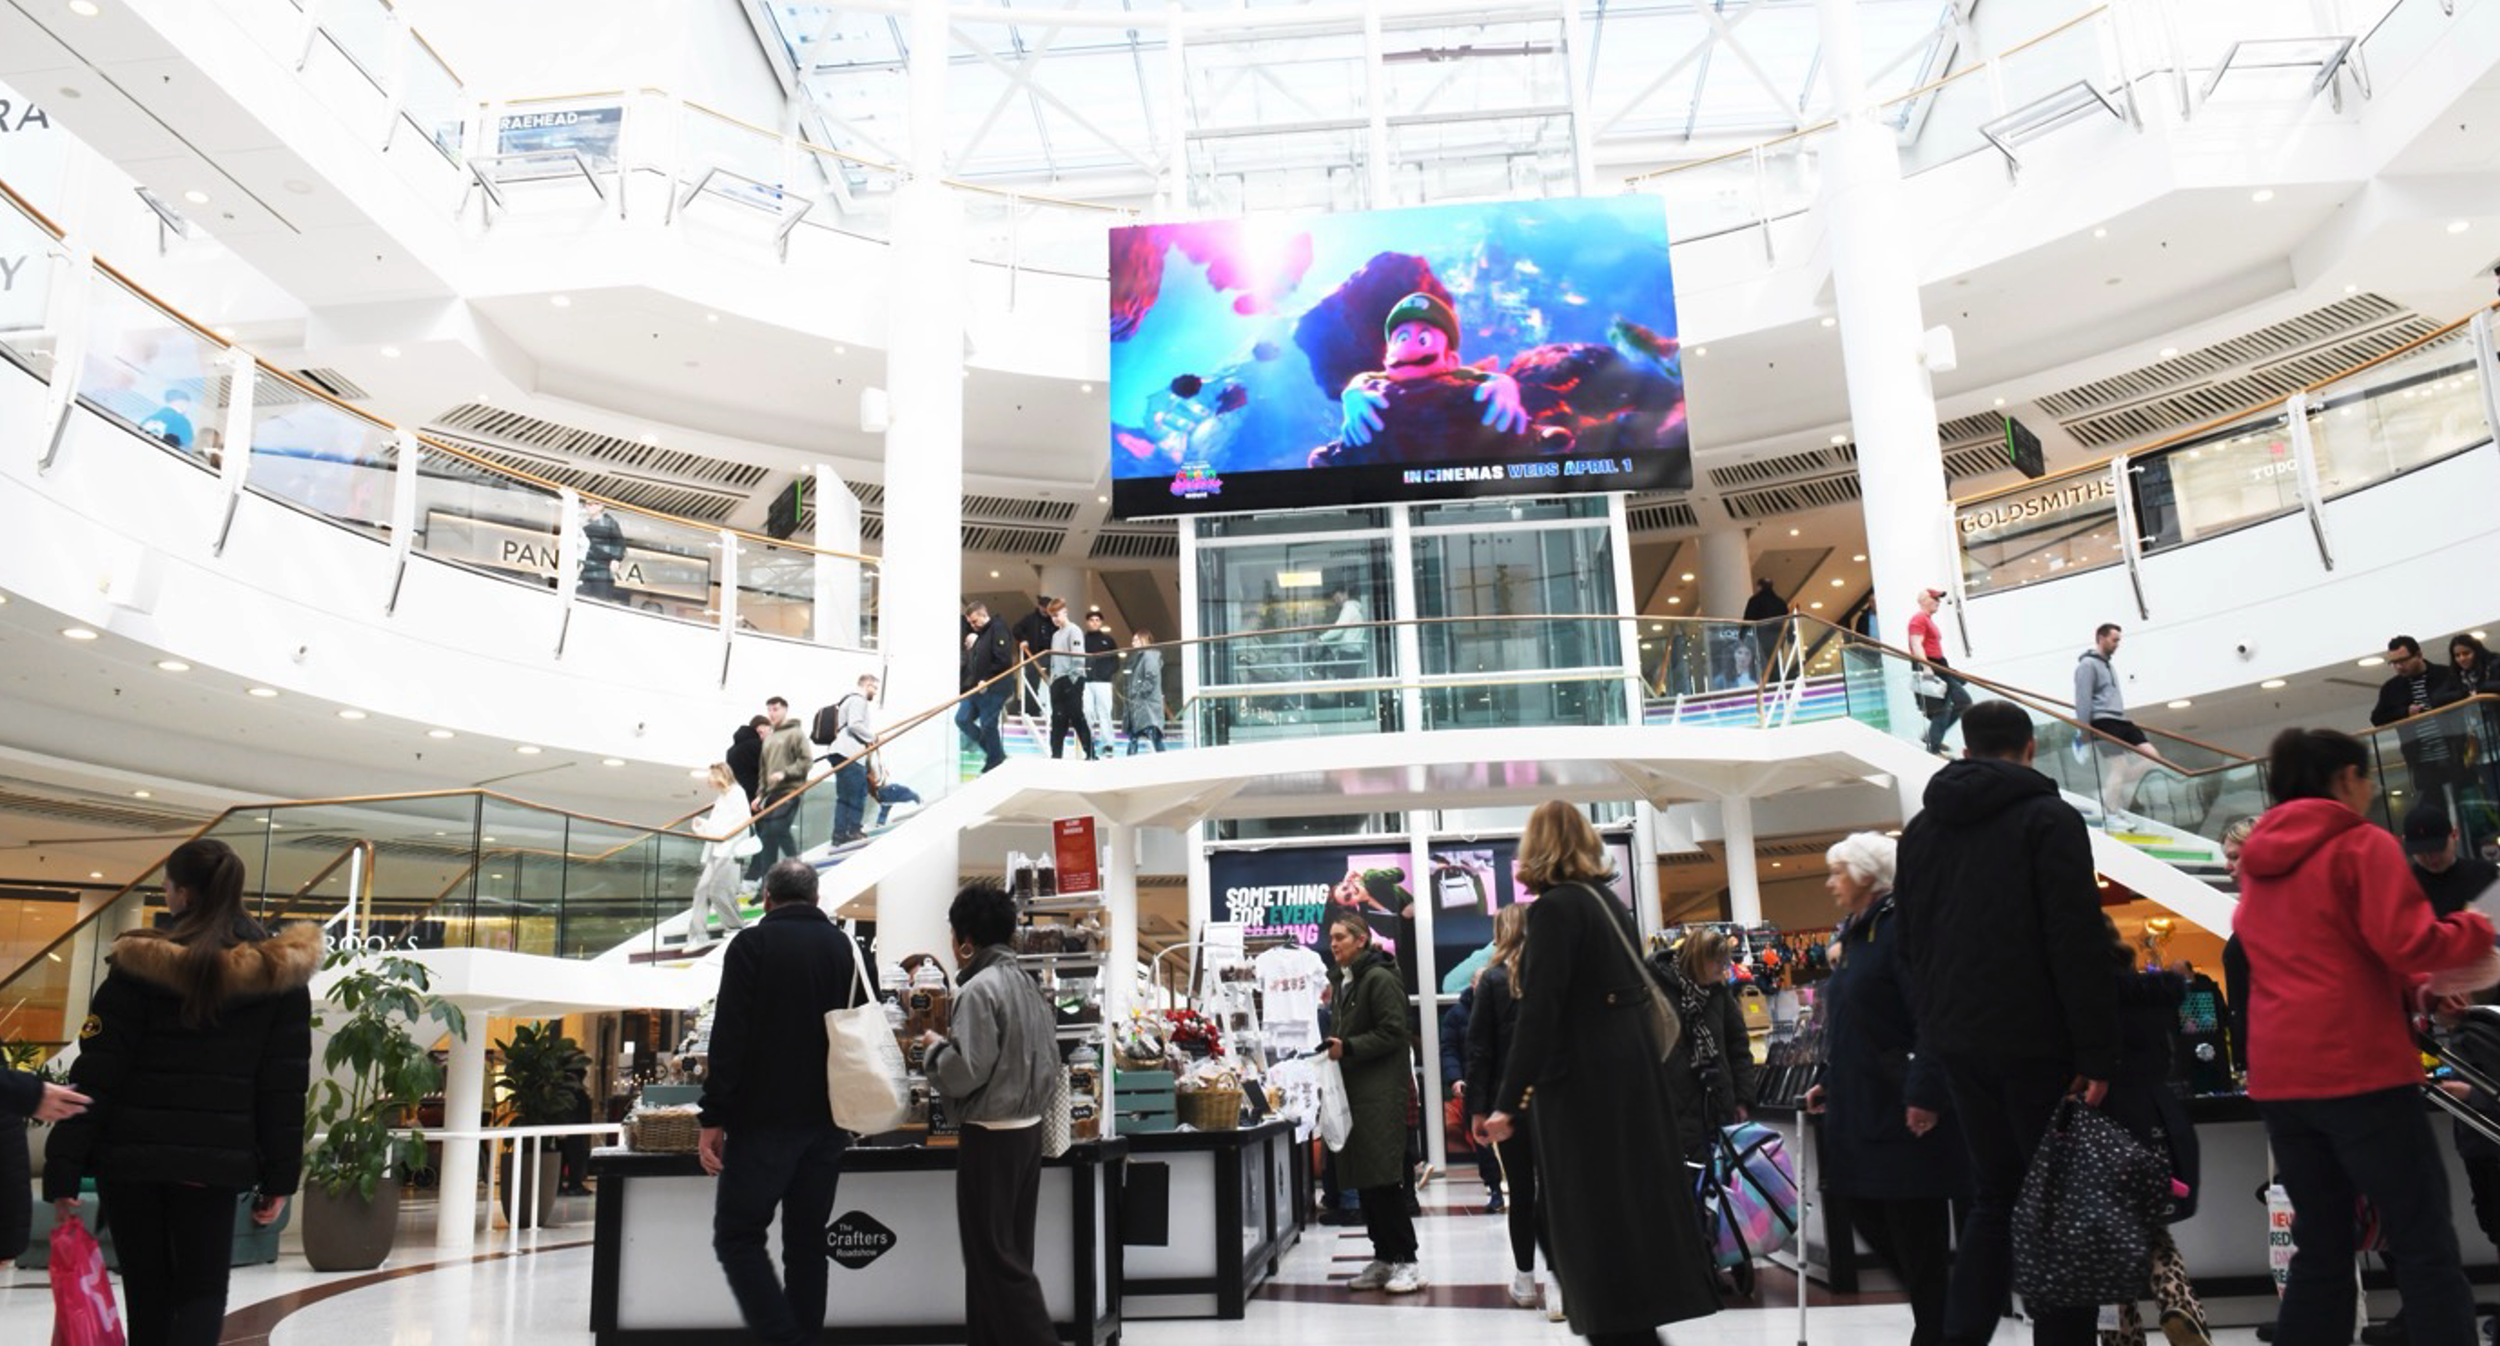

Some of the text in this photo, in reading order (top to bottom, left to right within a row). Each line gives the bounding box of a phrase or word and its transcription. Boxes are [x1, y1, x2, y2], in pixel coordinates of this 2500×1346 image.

[1403, 458, 1634, 484] IN CINEMAS WEDS APRIL 1
[2250, 458, 2298, 480] TUDO
[1960, 476, 2117, 534] GOLDSMITHS
[502, 539, 646, 585] PANA
[1225, 884, 1331, 909] SOMETHING
[1229, 904, 1326, 927] FOR EVERY
[839, 1222, 853, 1231] The
[826, 1230, 888, 1247] Crafters
[836, 1248, 878, 1258] Roadshow
